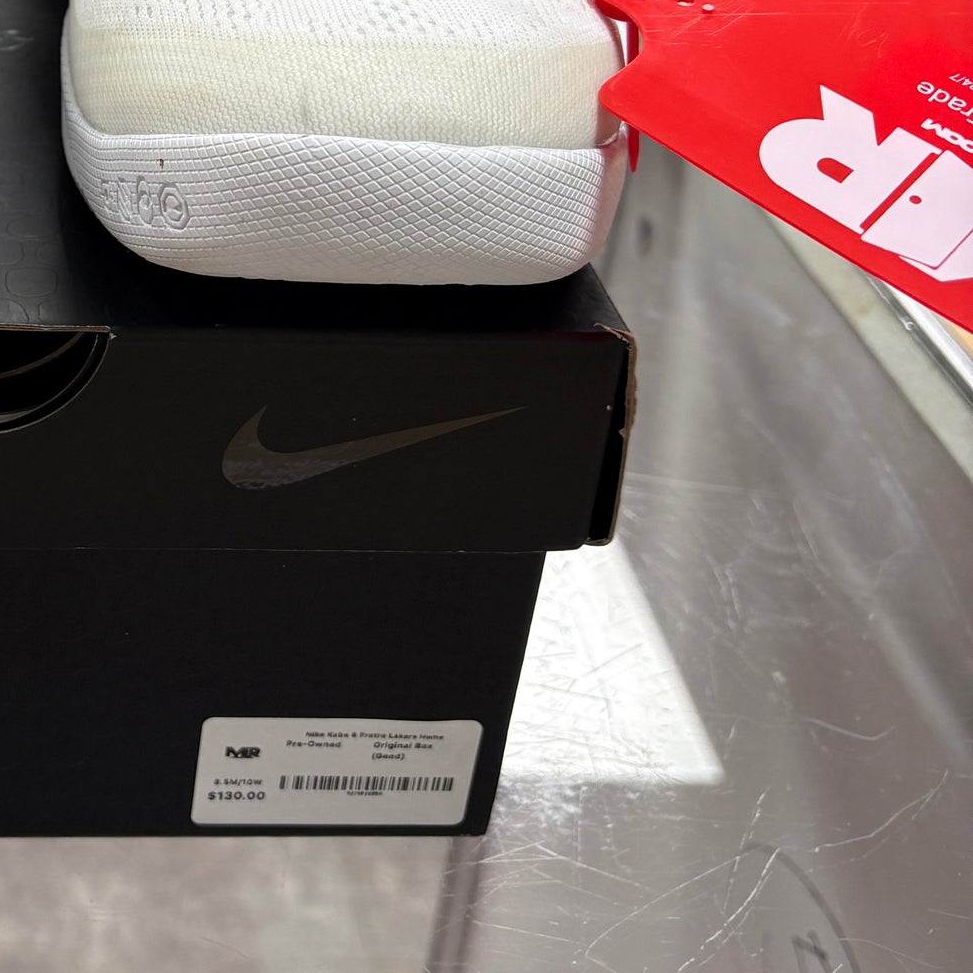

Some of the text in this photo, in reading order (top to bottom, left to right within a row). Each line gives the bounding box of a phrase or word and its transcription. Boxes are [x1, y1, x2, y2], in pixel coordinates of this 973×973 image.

[285, 740, 342, 748] Pre-Owned
[373, 741, 412, 750] Original
[208, 790, 266, 801] $130.00
